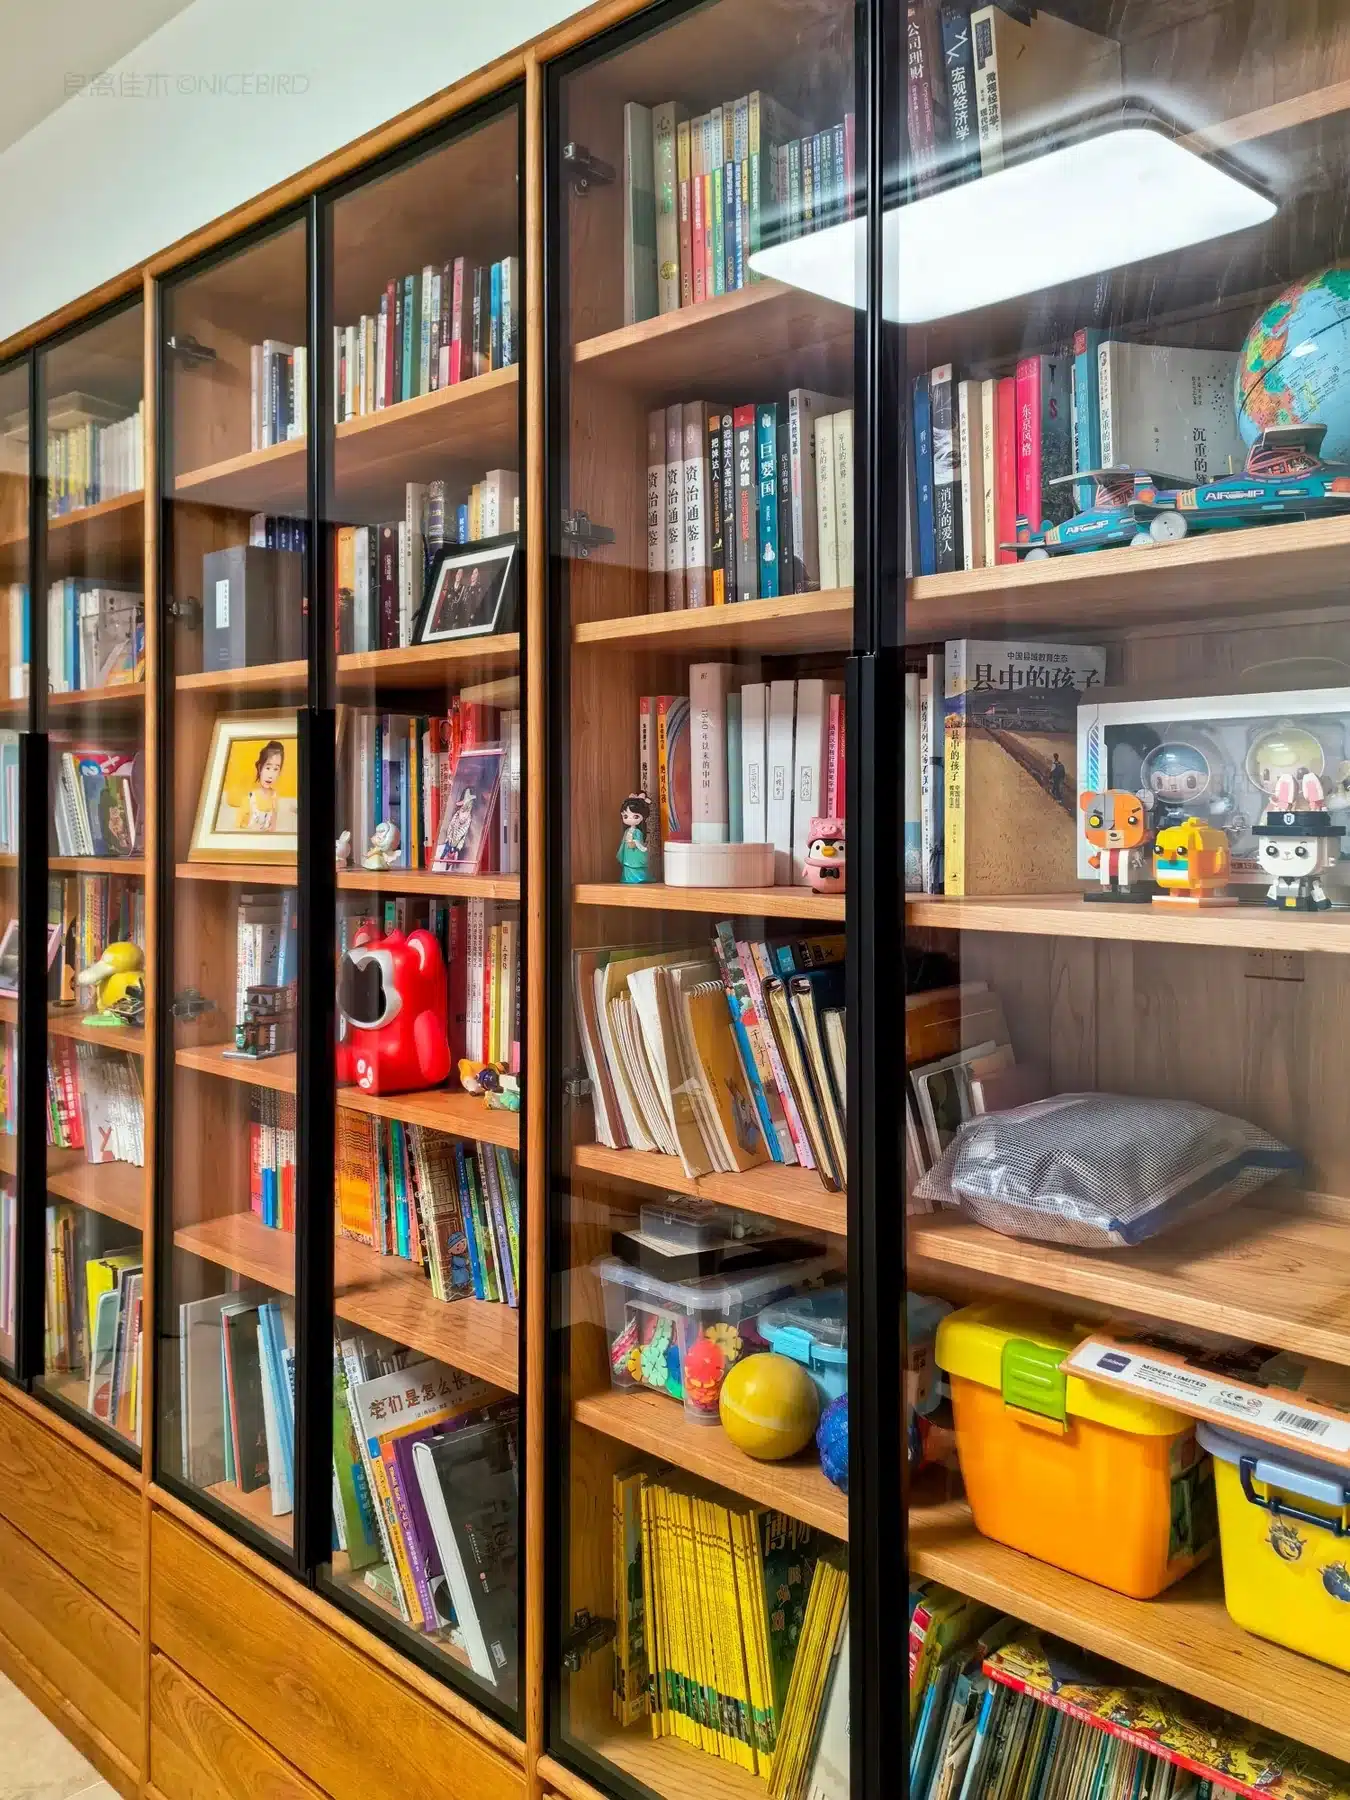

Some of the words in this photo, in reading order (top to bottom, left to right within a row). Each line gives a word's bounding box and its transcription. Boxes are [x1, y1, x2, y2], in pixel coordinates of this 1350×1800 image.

[908, 22, 924, 79] 公司理财
[951, 67, 970, 141] 宏观经济学
[986, 72, 999, 126] 微观经济学
[711, 437, 720, 481] 把妹达人
[723, 429, 732, 488] 把妹达人圣经
[739, 429, 750, 487] 野心优雅
[761, 440, 774, 498] 巨婴国
[648, 471, 659, 547] 资治通鉴
[667, 468, 679, 545] 资治通鉴
[686, 464, 700, 542] 资治通鉴
[940, 488, 952, 554] 消失的爱人
[970, 663, 1100, 693] 县中的孩子
[1007, 651, 1069, 663] 中国县域教育生态
[701, 709, 711, 789] 1840年以来的中国
[950, 730, 960, 781] 县中的孩子
[1141, 1363, 1173, 1377] MIDEER
[1173, 1374, 1207, 1388] LIMITED
